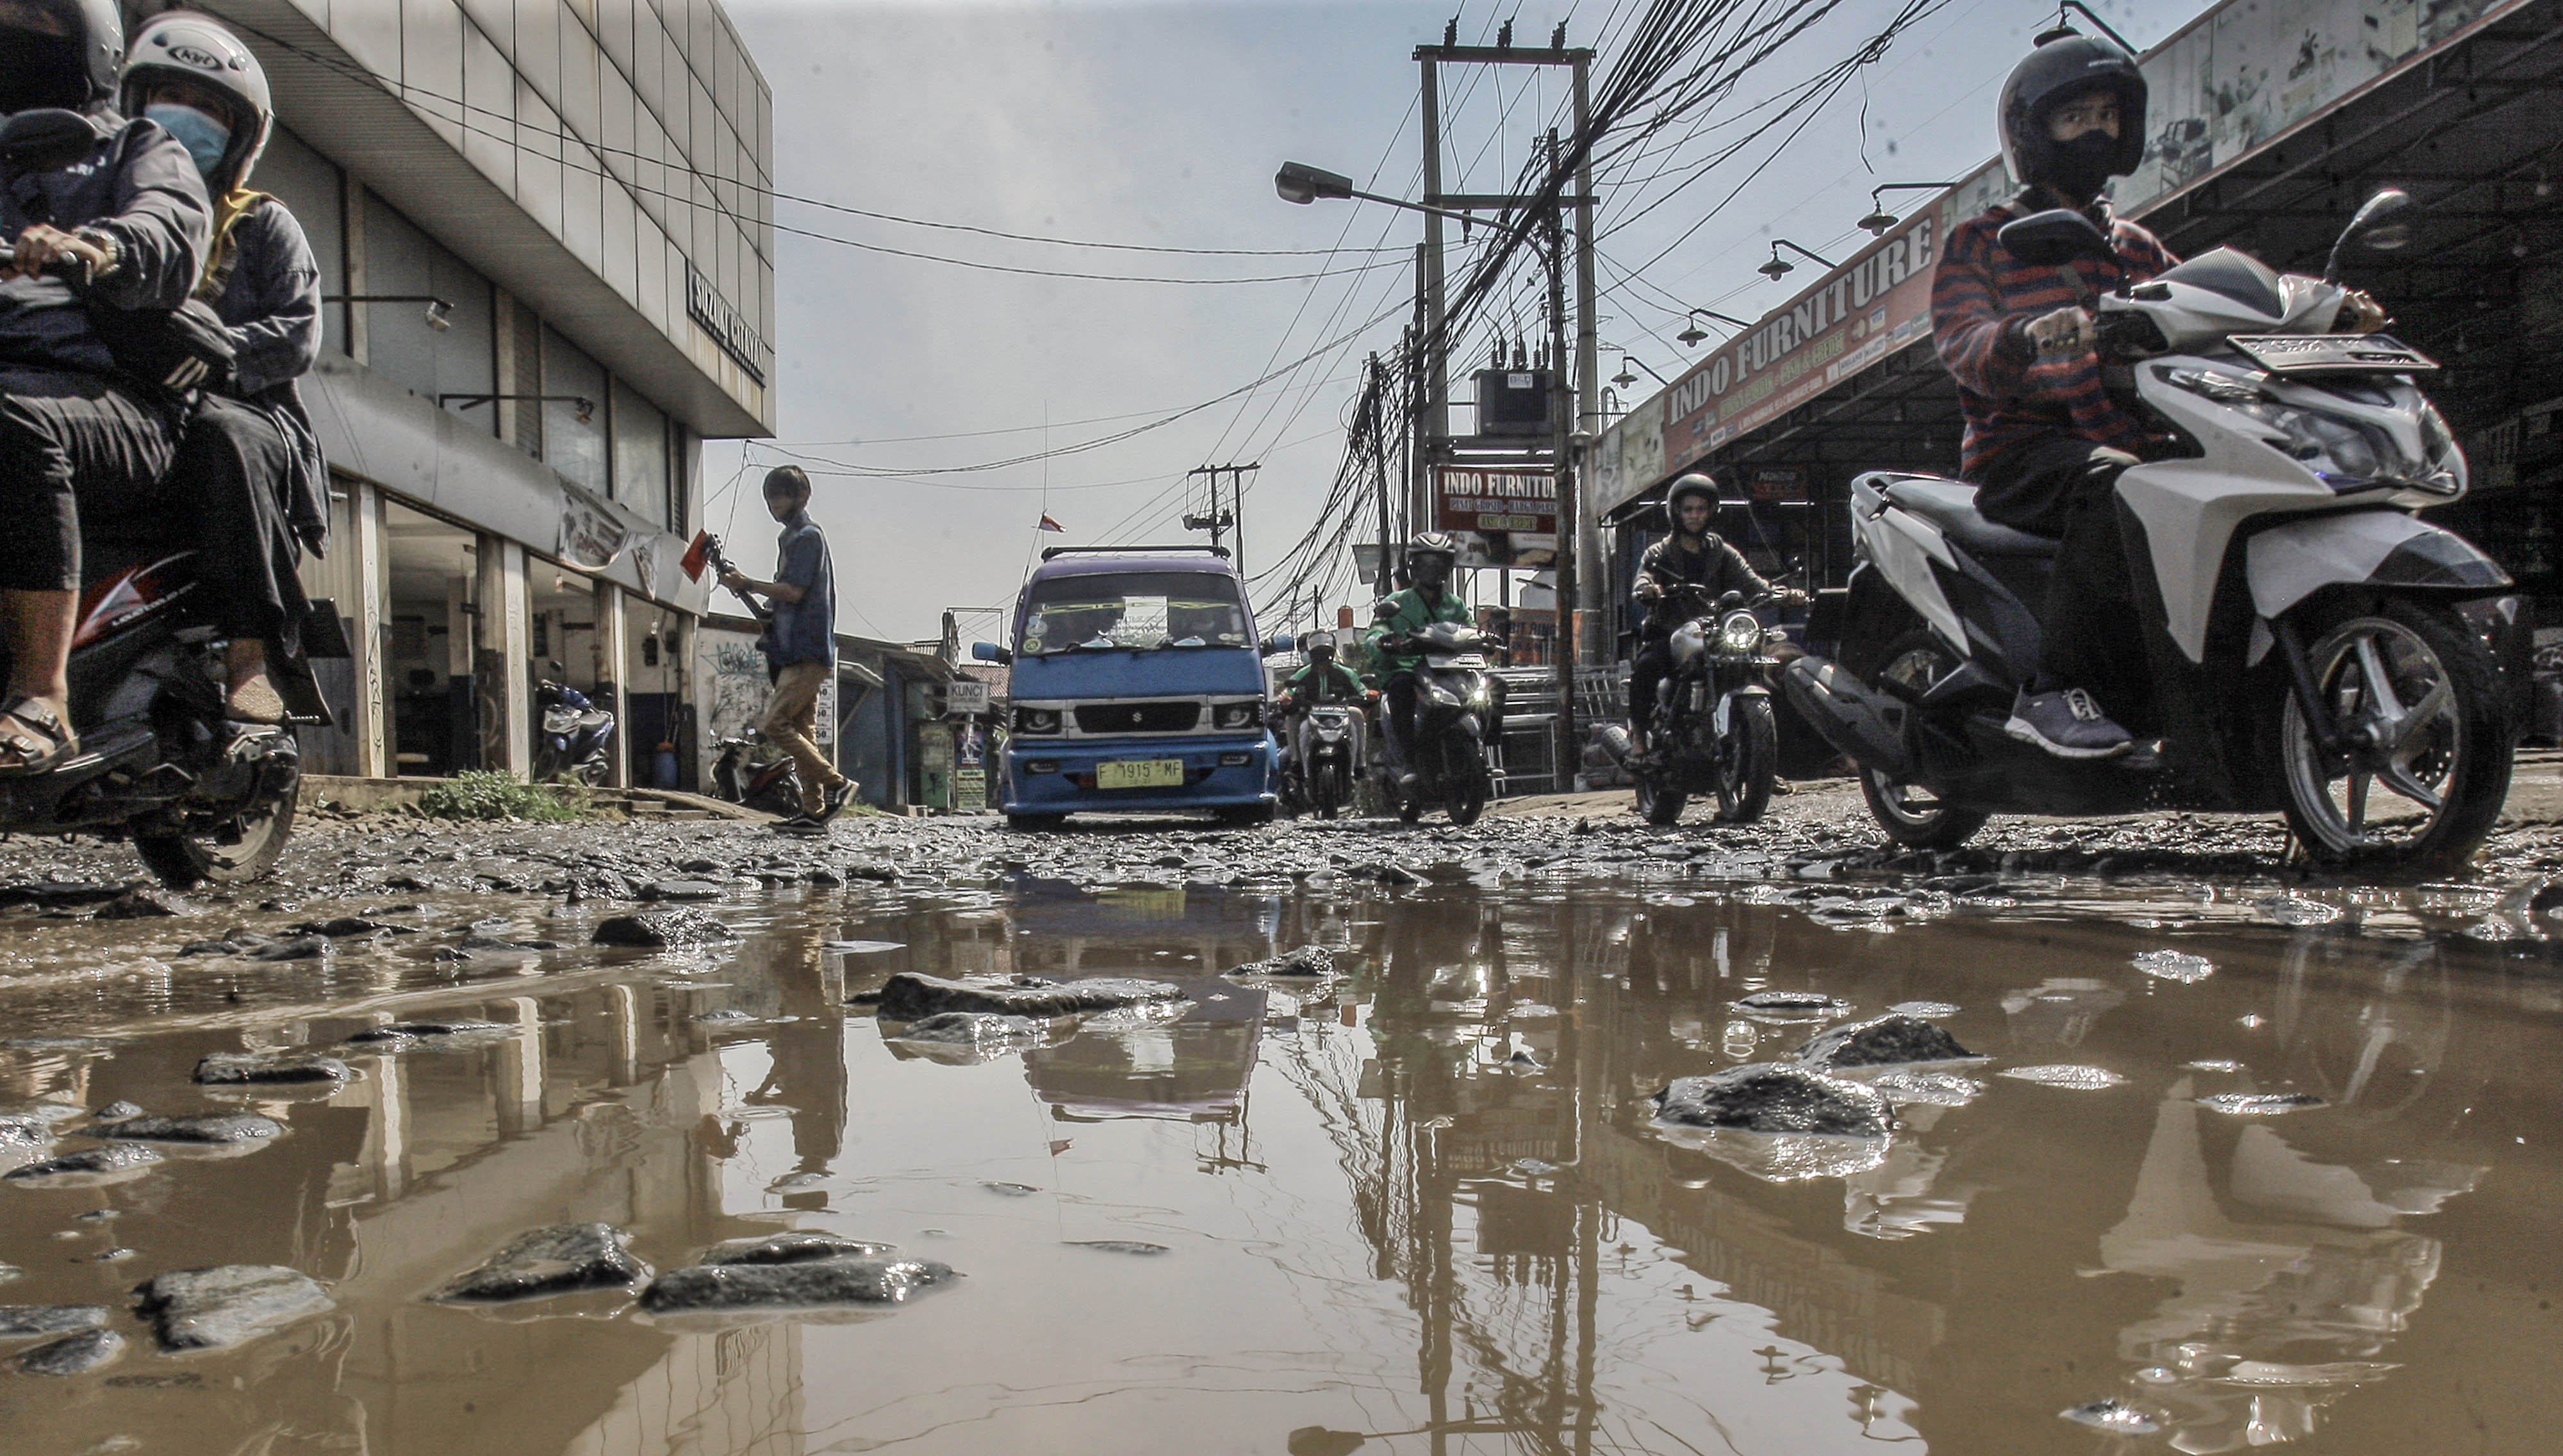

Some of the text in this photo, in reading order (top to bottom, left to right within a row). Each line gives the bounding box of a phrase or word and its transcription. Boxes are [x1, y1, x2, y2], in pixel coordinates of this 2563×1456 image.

[695, 273, 729, 339] SUZUKI
[1670, 356, 1730, 425] INDO
[1736, 217, 1933, 383] FURNITURE
[1444, 472, 1482, 495] INDO
[952, 685, 983, 697] KUNCI
[1099, 761, 1180, 779] F 1915 MF
